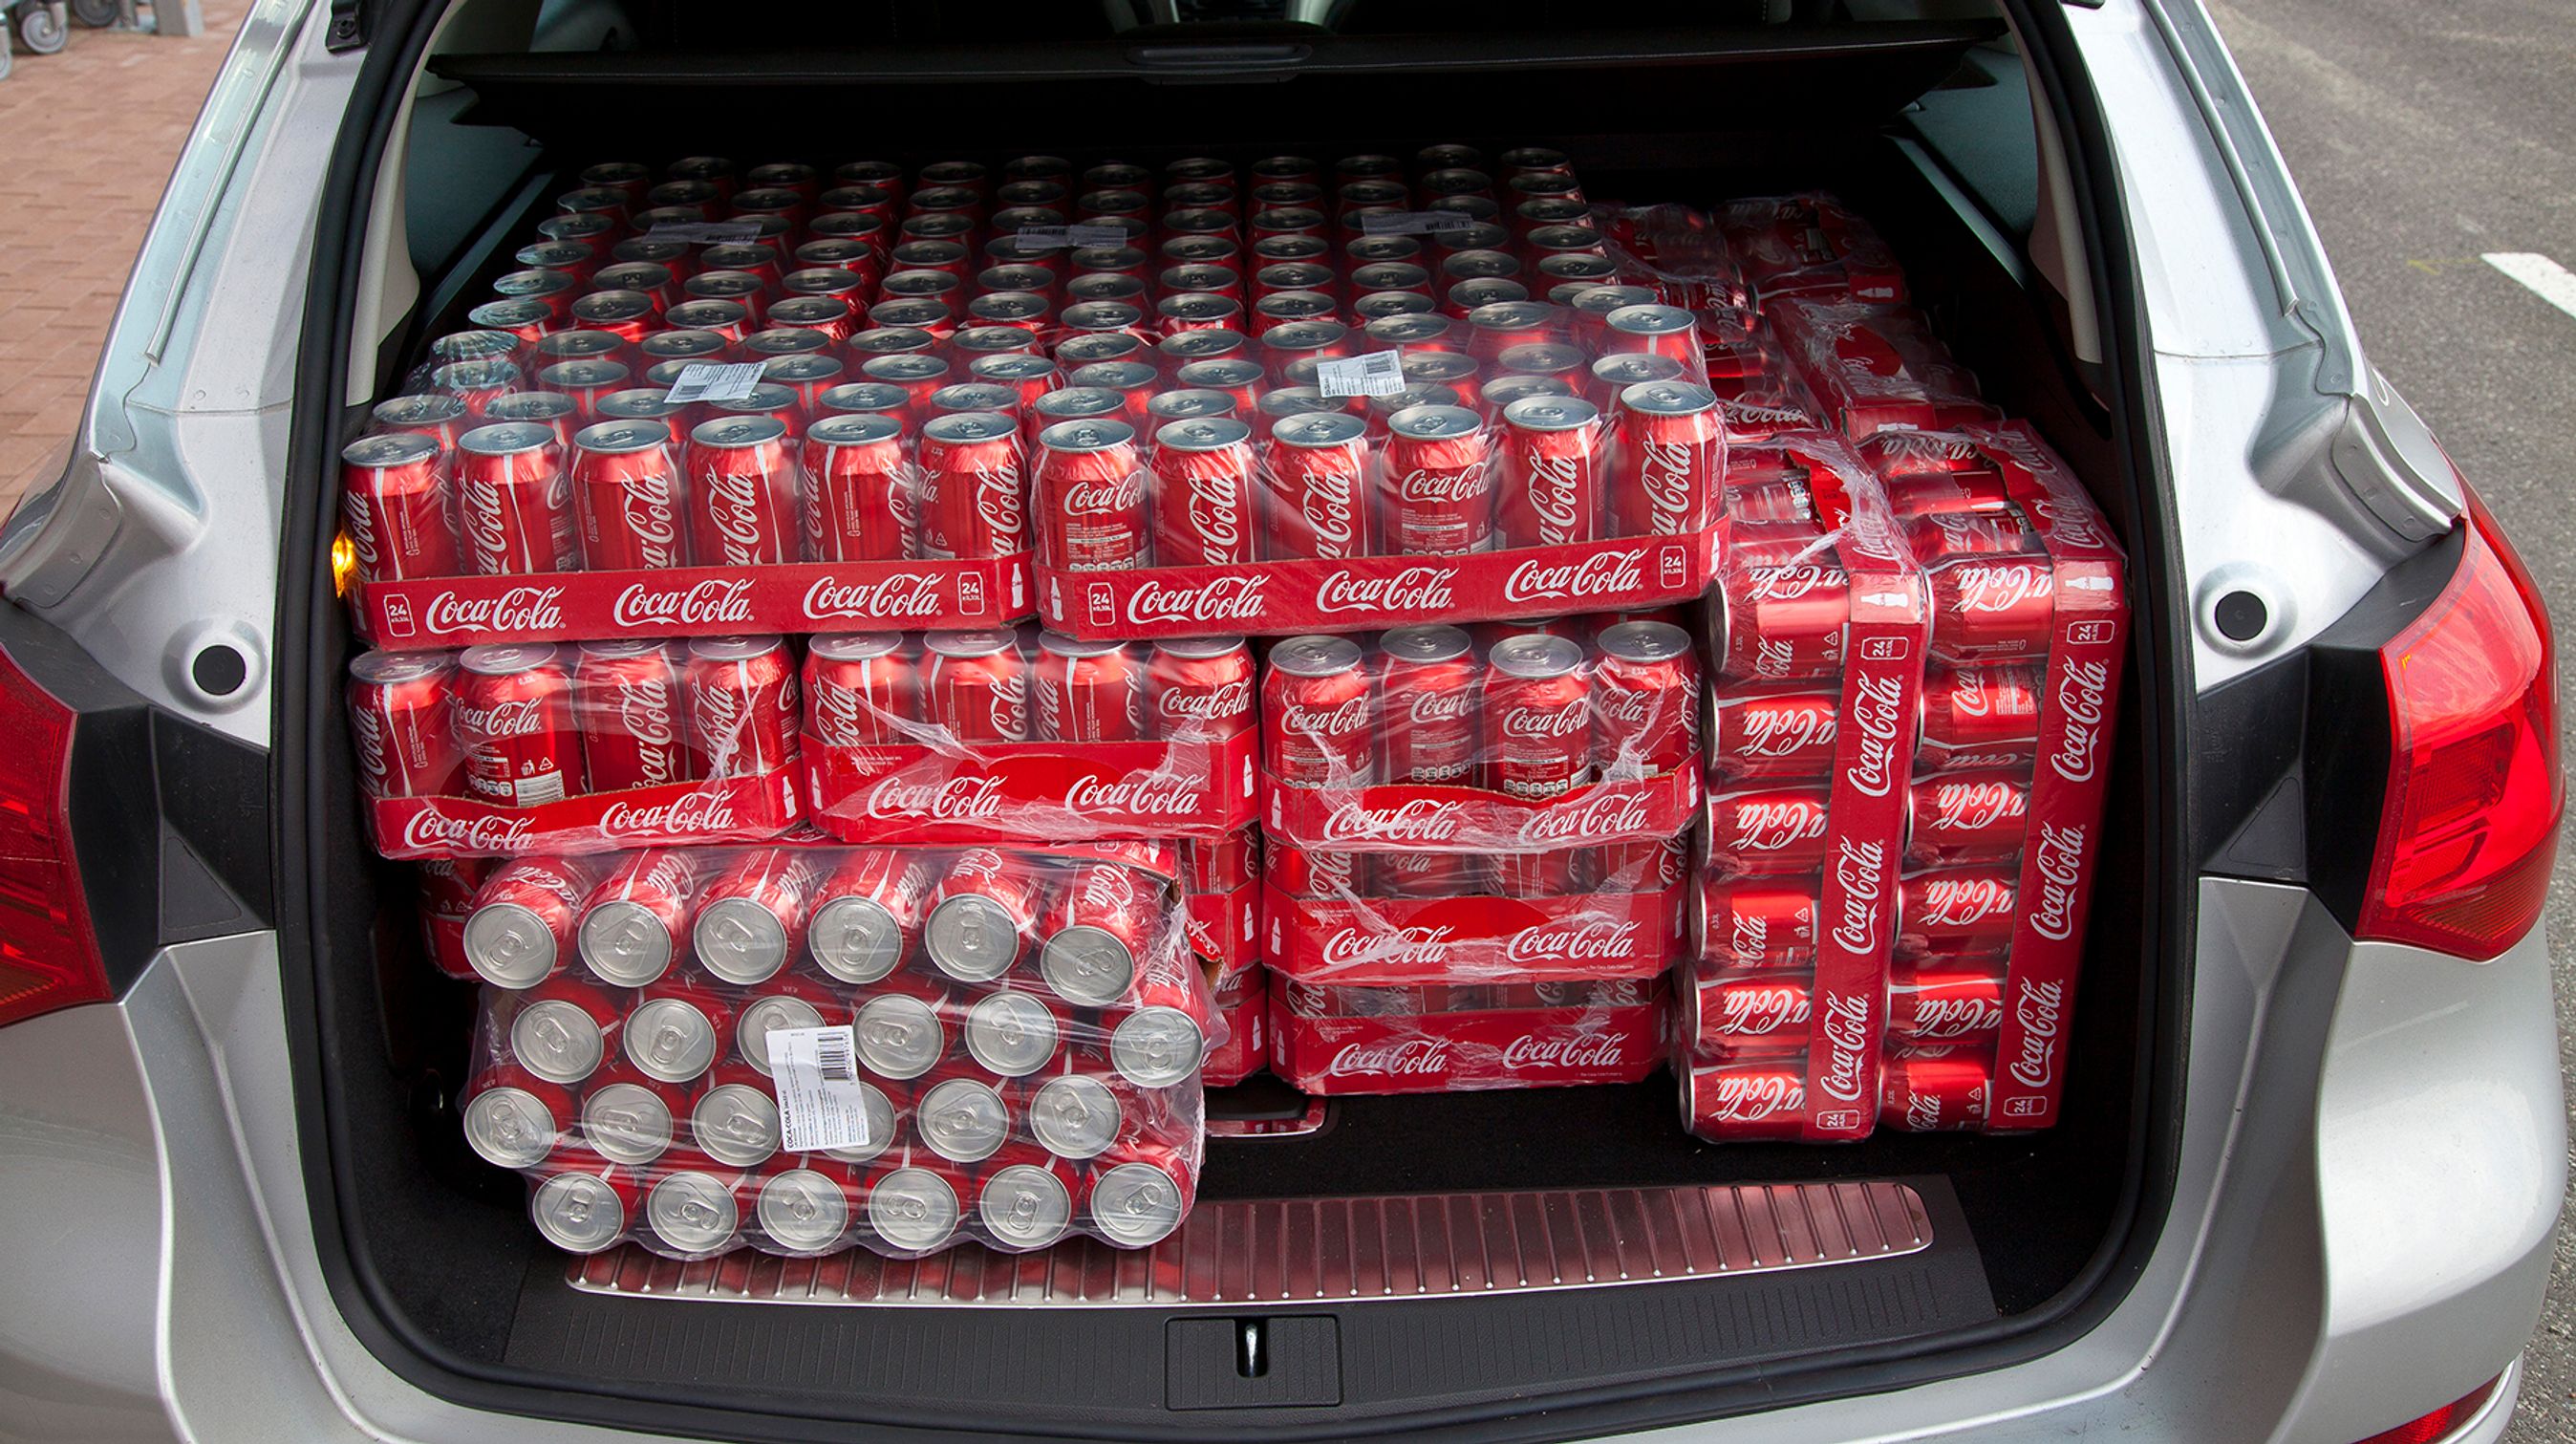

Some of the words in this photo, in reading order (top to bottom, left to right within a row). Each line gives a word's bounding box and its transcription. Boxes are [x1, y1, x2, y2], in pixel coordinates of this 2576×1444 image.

[1505, 548, 1649, 602] Coca-Cola
[1664, 556, 1682, 568] 24
[389, 604, 407, 616] 24
[426, 586, 566, 635] Coca-Cola
[613, 578, 756, 627] Coca-Cola
[804, 572, 946, 619] Coca-Cola
[962, 582, 979, 593] 24
[1092, 593, 1110, 605] 24
[1127, 574, 1271, 624] Coca-Cola
[1317, 567, 1459, 614] Coca-Cola
[1950, 566, 2053, 612] a-Cola
[1873, 641, 1885, 656] 24
[2078, 624, 2091, 639] 24
[1734, 708, 1837, 757] a-Cola
[1847, 670, 1901, 796] Coca-Cola
[2051, 655, 2108, 782] Coca-Cola
[600, 789, 737, 838] Coca-Cola
[868, 775, 1008, 820] Coca-Cola
[1064, 773, 1206, 815] Coca-Cola
[1929, 781, 2030, 830] a-Cola
[404, 808, 536, 851] Coca-Cola
[1323, 799, 1463, 842] Coca-Cola
[1517, 790, 1653, 845] Coca-Cola
[1728, 802, 1829, 851] a-Cola
[1833, 834, 1883, 955] Coca-Cola
[1918, 878, 2019, 926] a-Cola
[2029, 821, 2084, 940] Coca-Cola
[1507, 920, 1642, 962] Coca-Cola
[1715, 989, 1813, 1035] a-Cola
[1900, 998, 2004, 1038] a-Cola
[2009, 976, 2064, 1088] Coca-Cola
[1331, 1040, 1452, 1077] Coca-Cola
[1503, 1033, 1629, 1069] Coca-Cola
[1821, 990, 1868, 1101] Coca-Cola
[1828, 1113, 1838, 1128] 24
[2014, 1100, 2026, 1113] 24
